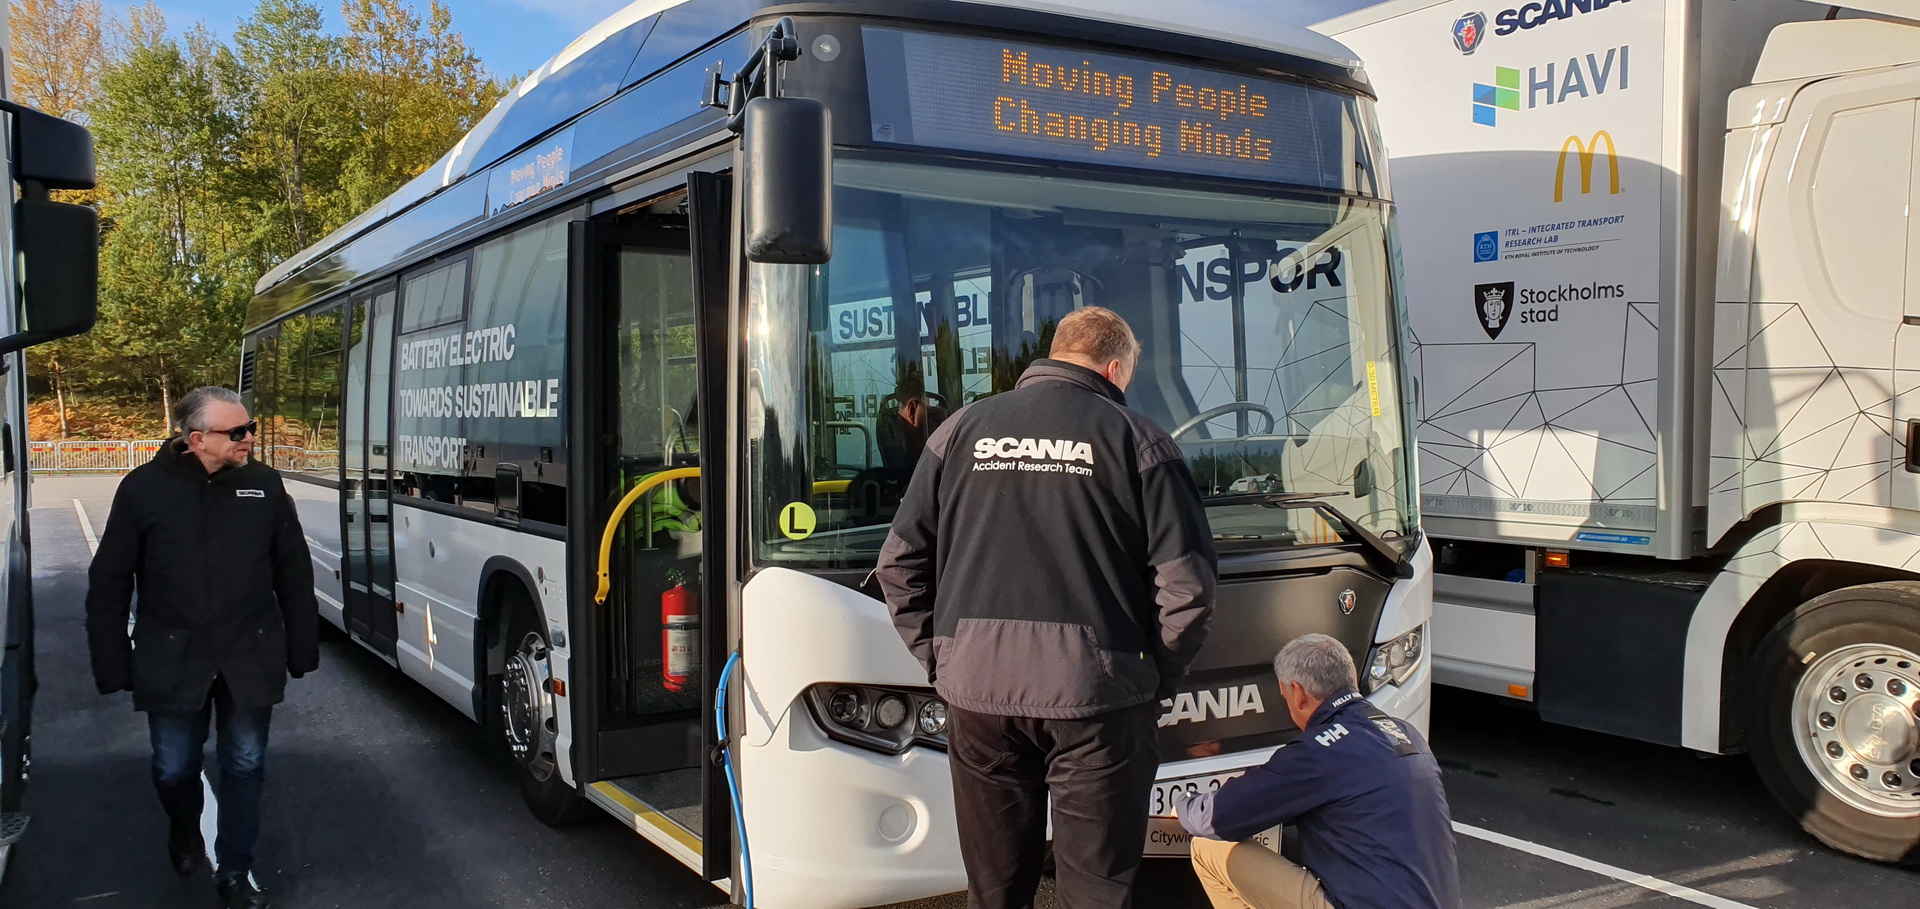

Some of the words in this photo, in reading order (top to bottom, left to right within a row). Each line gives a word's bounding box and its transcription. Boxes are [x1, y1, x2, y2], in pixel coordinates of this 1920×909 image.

[1495, 0, 1633, 36] SCAN
[1003, 48, 1134, 108] Moving
[1152, 71, 1269, 121] People
[1528, 45, 1629, 109] HAVI
[994, 96, 1162, 157] Changing
[1179, 119, 1272, 161] Minds
[1504, 228, 1520, 237] ITRL
[1528, 221, 1576, 234] INTEGRATED
[1577, 215, 1625, 228] TRANSPORT
[1504, 237, 1542, 248] RESEARCH
[1543, 235, 1559, 244] LAB
[1564, 245, 1600, 254] TECHNOLOGY
[1176, 245, 1342, 303] NSPOR
[1519, 281, 1625, 304] Stockholms
[1520, 305, 1559, 323] stad
[401, 336, 449, 371] BATTERY
[449, 323, 516, 367] ELECTRIC
[400, 386, 453, 419] TOWARDS
[455, 378, 559, 419] SUSTAINABLE
[1370, 382, 1380, 415] METER
[399, 434, 467, 470] TRANSPORT
[973, 437, 1094, 465] SCANIA
[972, 461, 1016, 472] Accident
[1018, 461, 1063, 472] Research
[1064, 463, 1093, 477] Team
[789, 506, 808, 534] L
[1157, 683, 1265, 728] CANIA
[1332, 693, 1352, 708] HELLY
